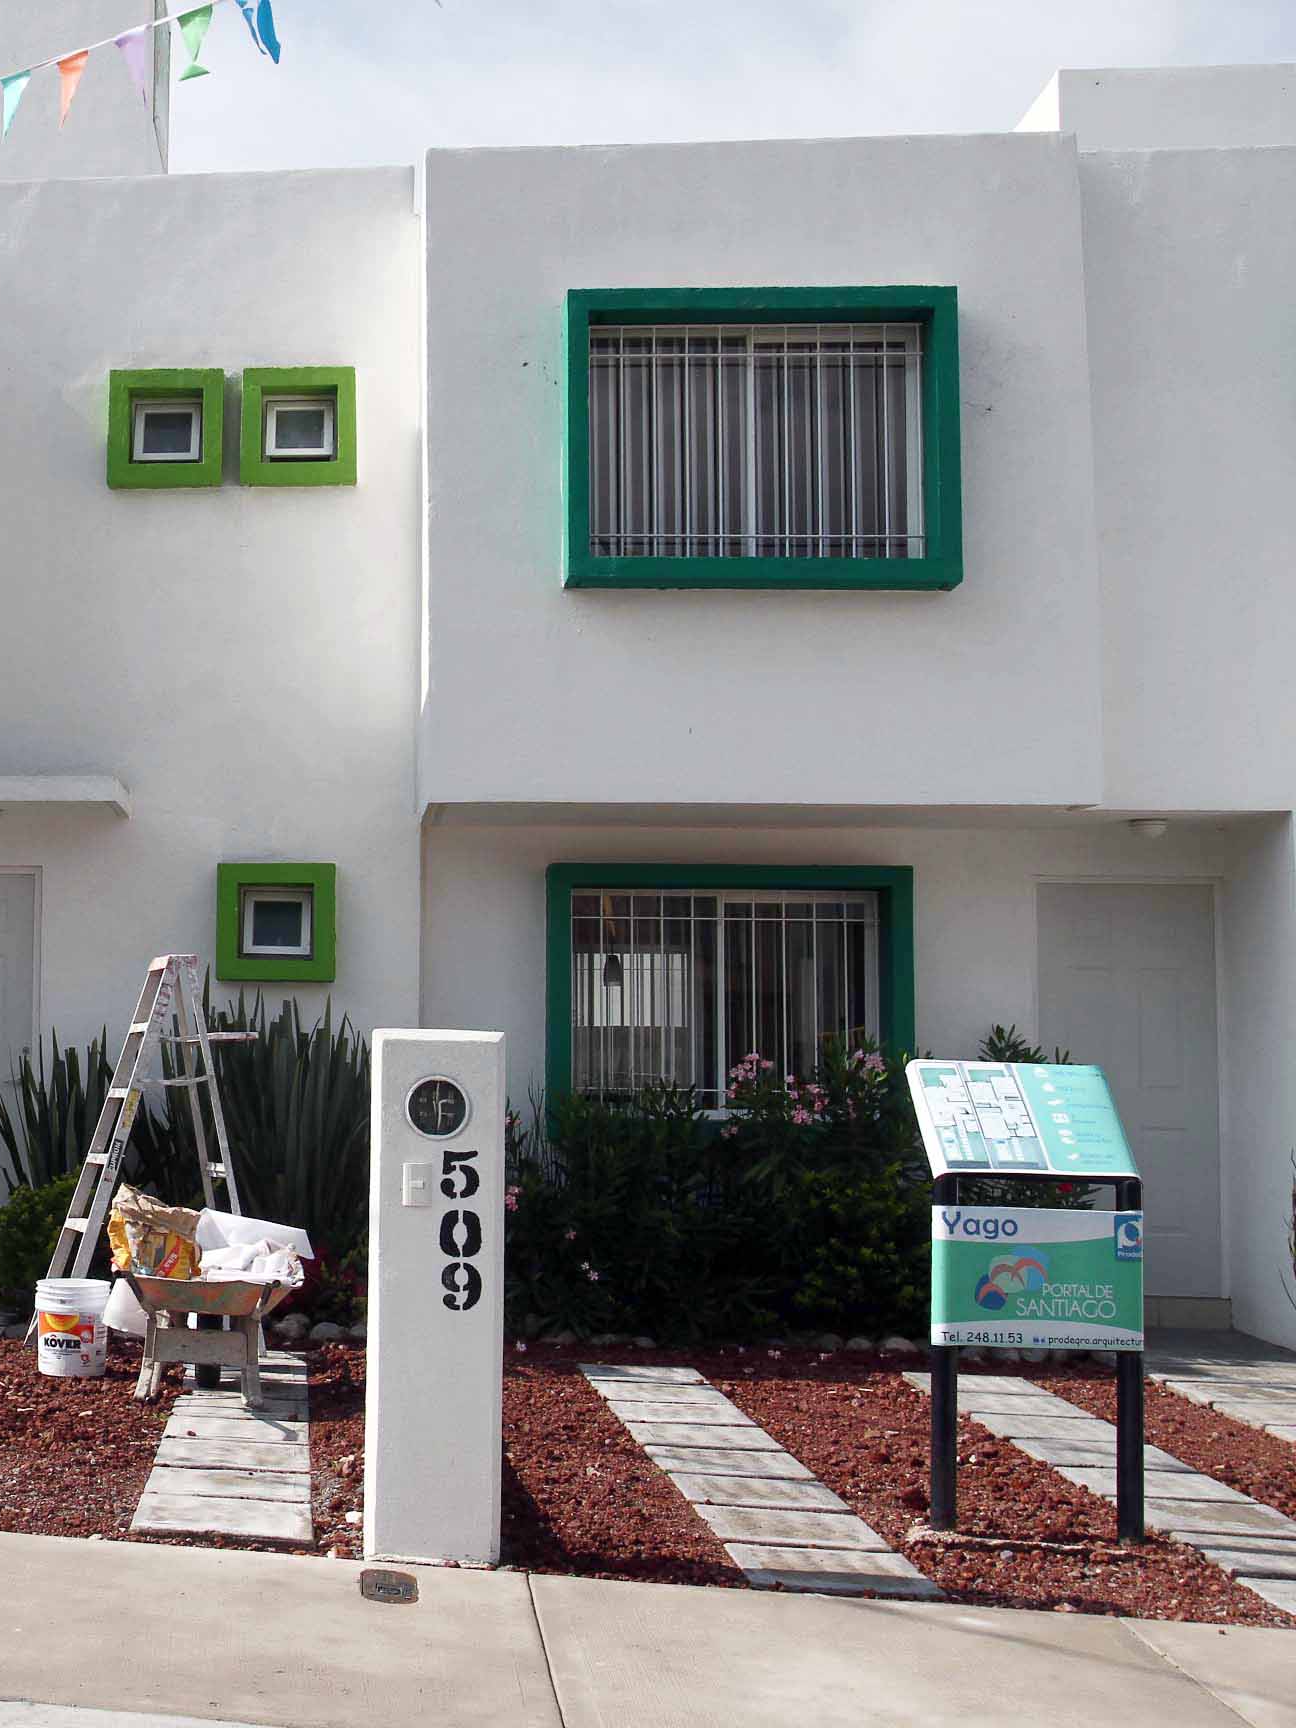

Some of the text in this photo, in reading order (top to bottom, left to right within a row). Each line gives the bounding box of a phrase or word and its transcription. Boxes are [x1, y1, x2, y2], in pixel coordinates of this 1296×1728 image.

[942, 1211, 1019, 1239] Yago
[1042, 1283, 1113, 1299] PORTAL DE
[1016, 1299, 1117, 1319] SANTIAGO
[942, 1331, 963, 1343] Tel.
[967, 1331, 1023, 1344] 248.11.53
